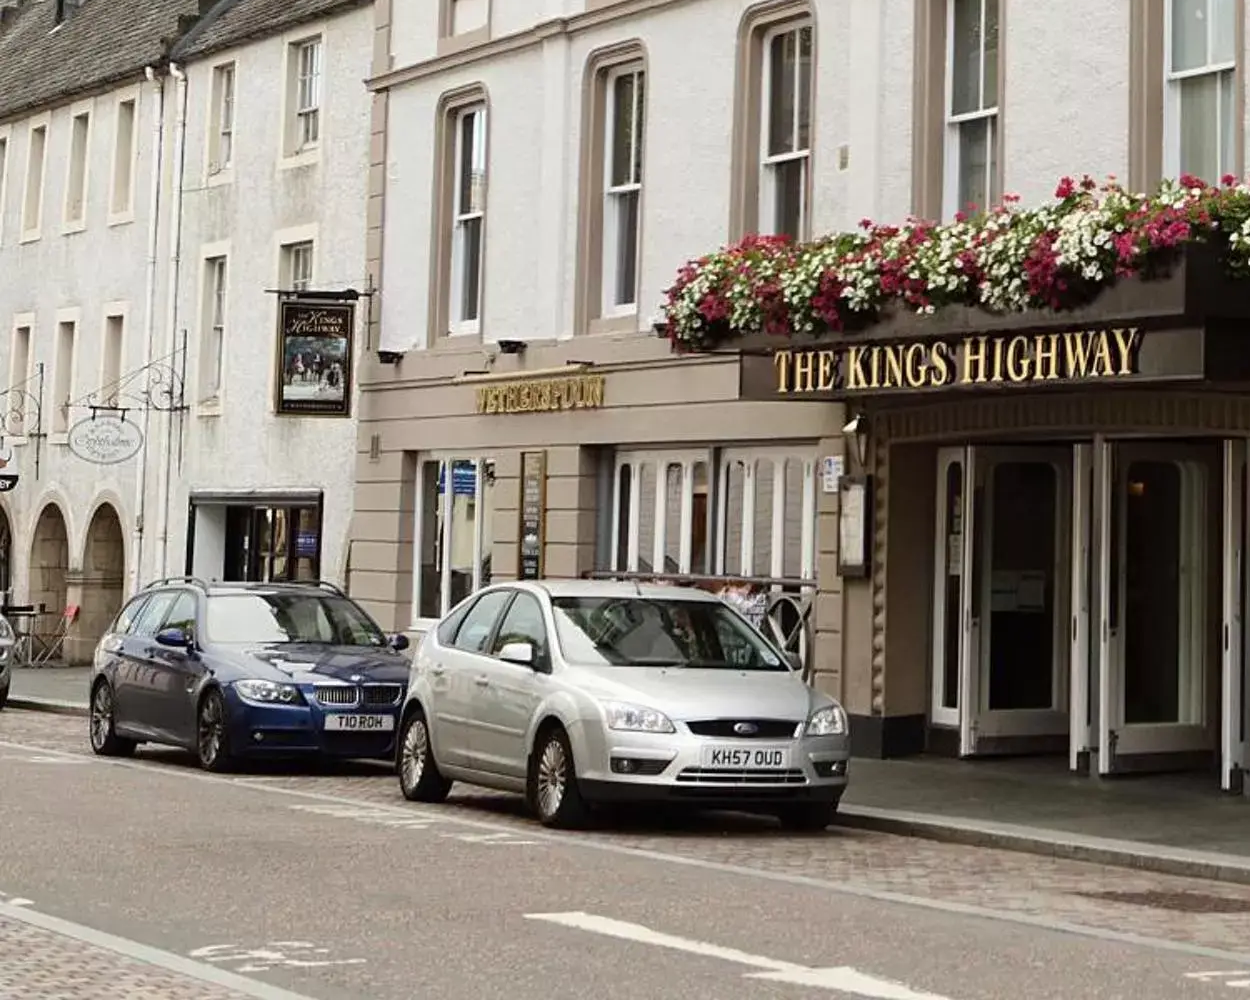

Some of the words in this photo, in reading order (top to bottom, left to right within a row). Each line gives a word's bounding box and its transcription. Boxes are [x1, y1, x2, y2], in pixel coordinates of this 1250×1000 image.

[774, 350, 835, 393] THE
[845, 341, 949, 390] KINGS
[960, 327, 1138, 384] HIGHWAY
[711, 749, 751, 765] KH57
[754, 750, 783, 766] OUD
